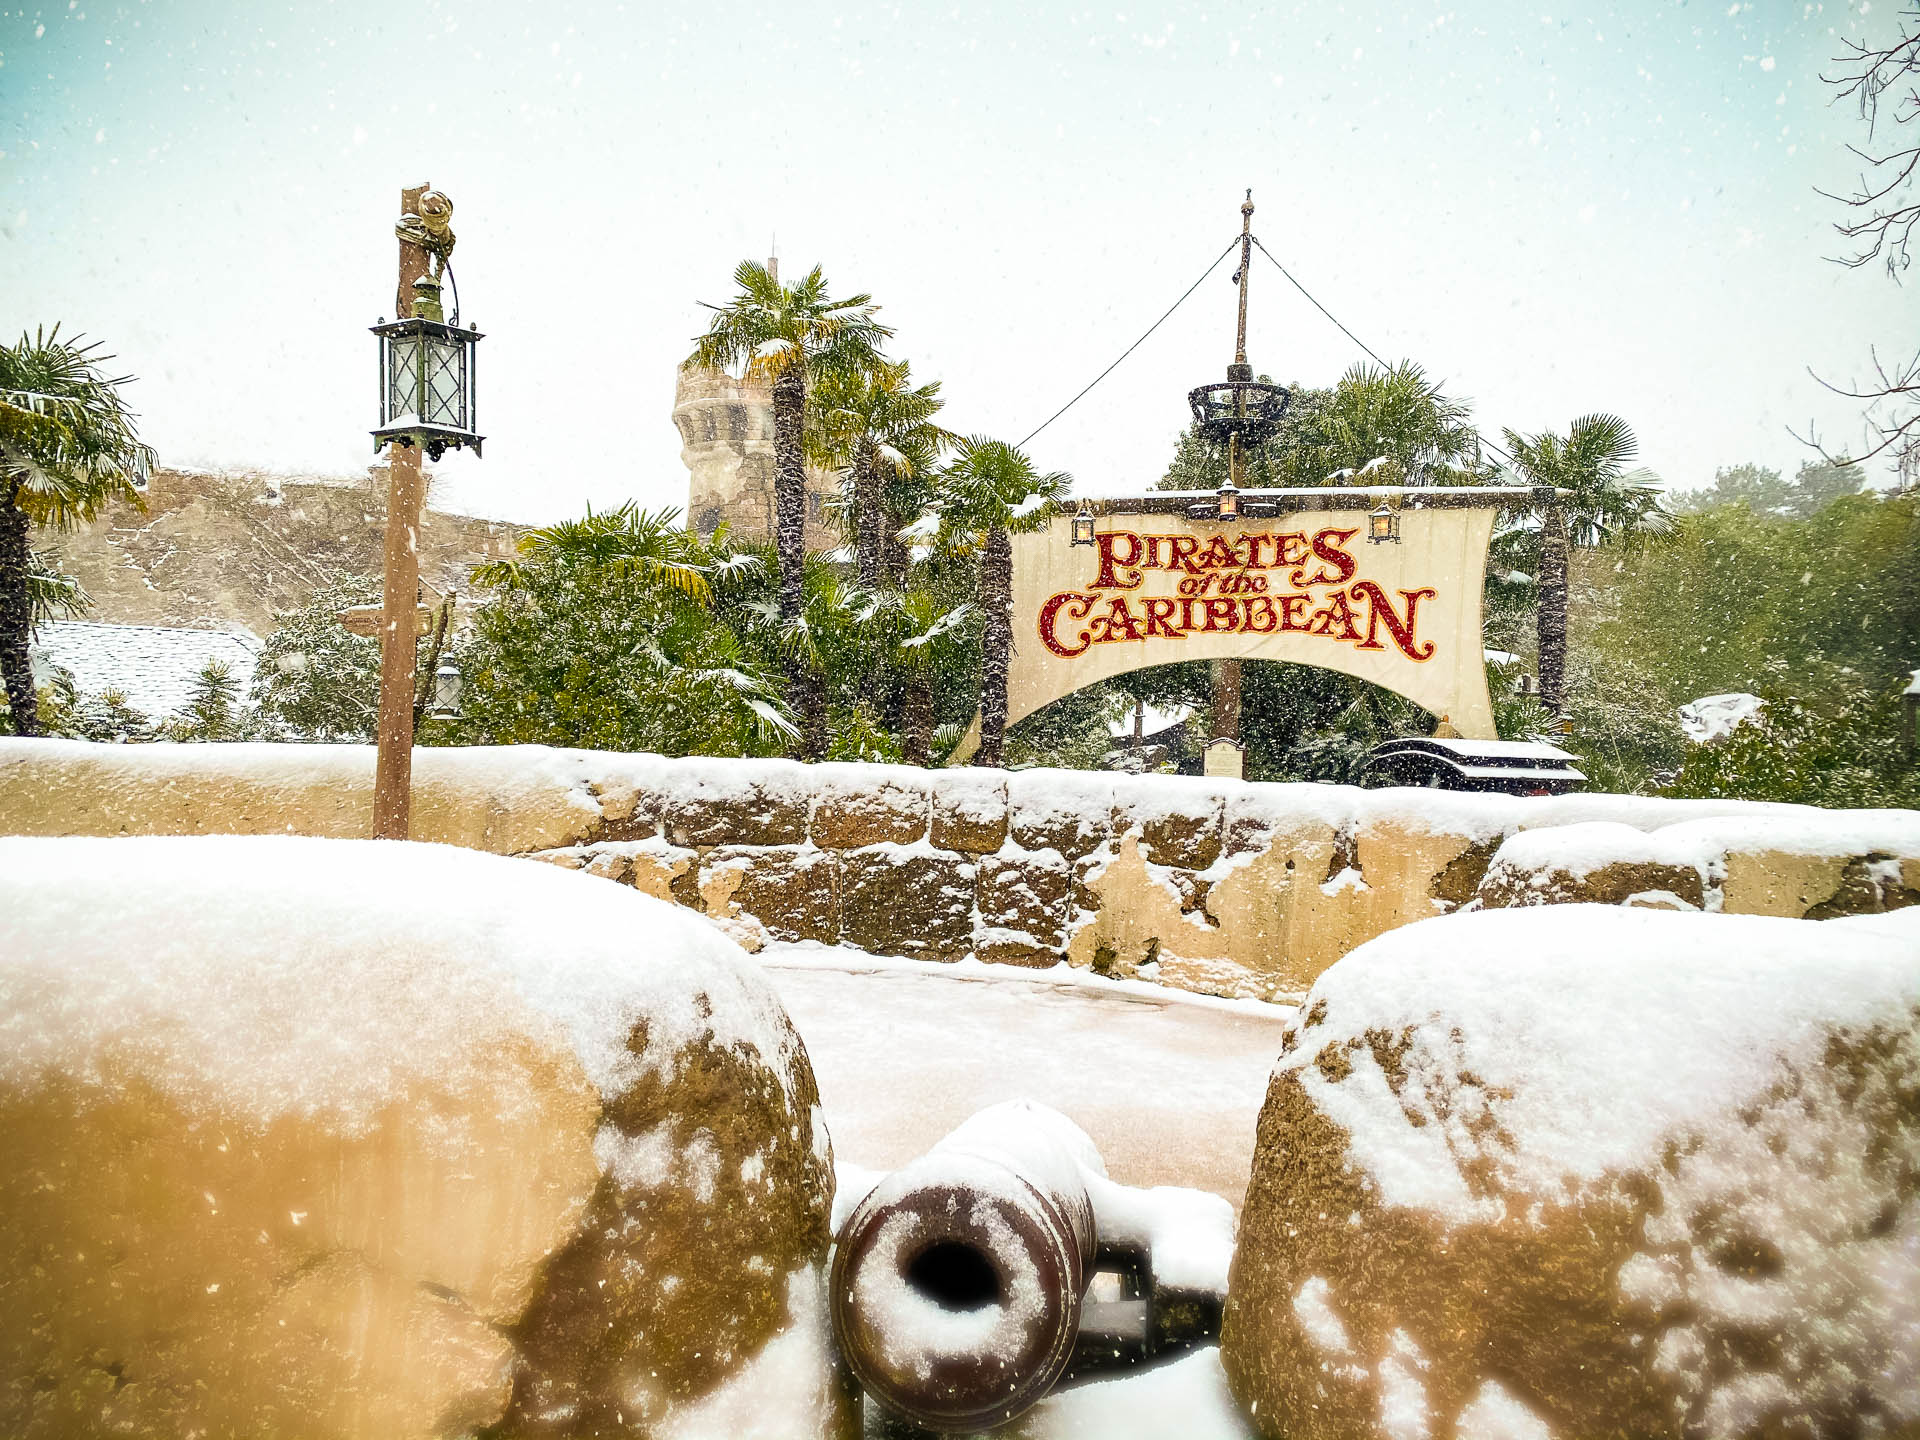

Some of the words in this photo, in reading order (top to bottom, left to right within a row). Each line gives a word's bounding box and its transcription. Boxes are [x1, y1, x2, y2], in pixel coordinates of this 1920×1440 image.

[1087, 527, 1360, 590] PIRATES
[1178, 572, 1219, 597] of
[1219, 573, 1268, 595] the
[1038, 580, 1436, 662] CARIBBEAN
